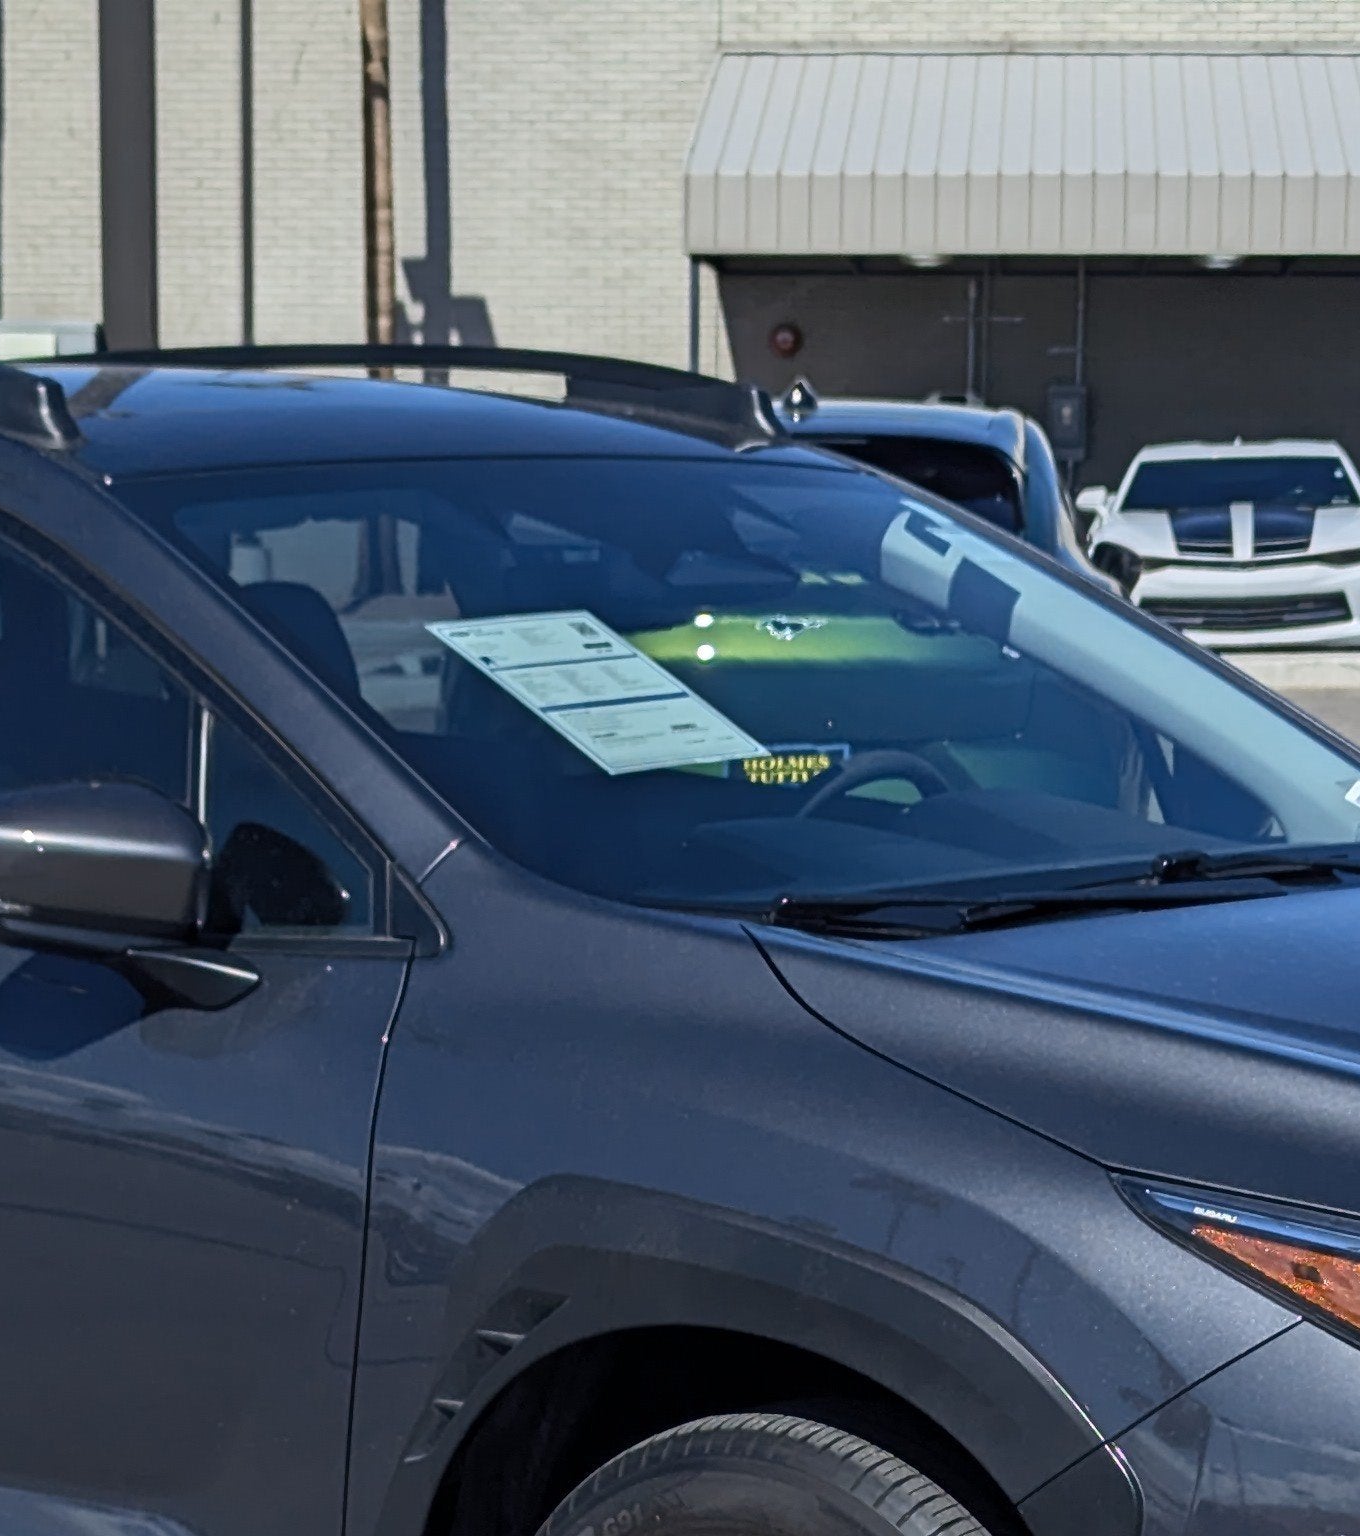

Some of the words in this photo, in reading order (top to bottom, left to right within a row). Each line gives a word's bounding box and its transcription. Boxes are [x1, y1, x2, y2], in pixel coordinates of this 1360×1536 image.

[743, 754, 831, 771] HOLMES
[748, 769, 812, 784] TUTTL
[1193, 1206, 1238, 1224] SUBARU
